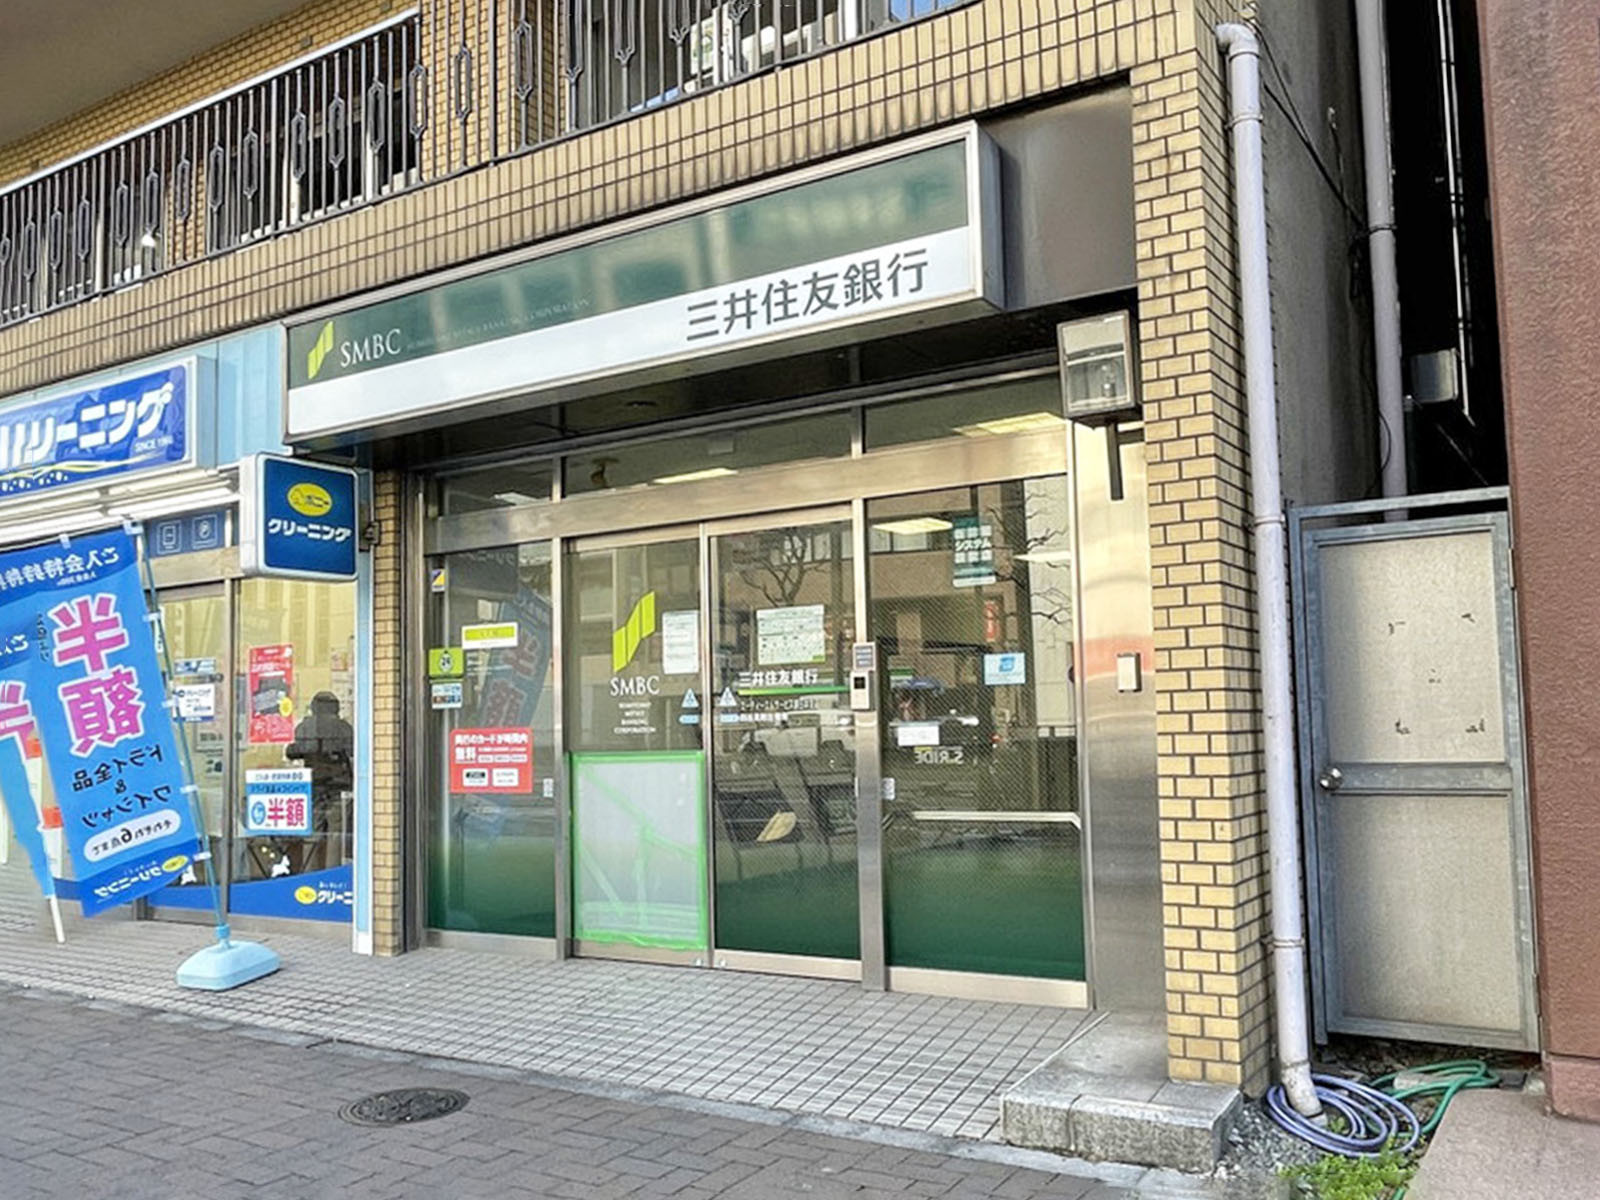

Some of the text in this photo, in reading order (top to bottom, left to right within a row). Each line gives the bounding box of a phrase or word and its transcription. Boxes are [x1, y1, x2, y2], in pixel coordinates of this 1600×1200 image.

[686, 249, 928, 341] 三井住友銀行
[340, 328, 401, 368] SMBC
[268, 518, 352, 541] クリーニング
[610, 676, 660, 696] SMBC
[738, 669, 819, 687] 三井住友銀行
[267, 798, 305, 827] 半額
